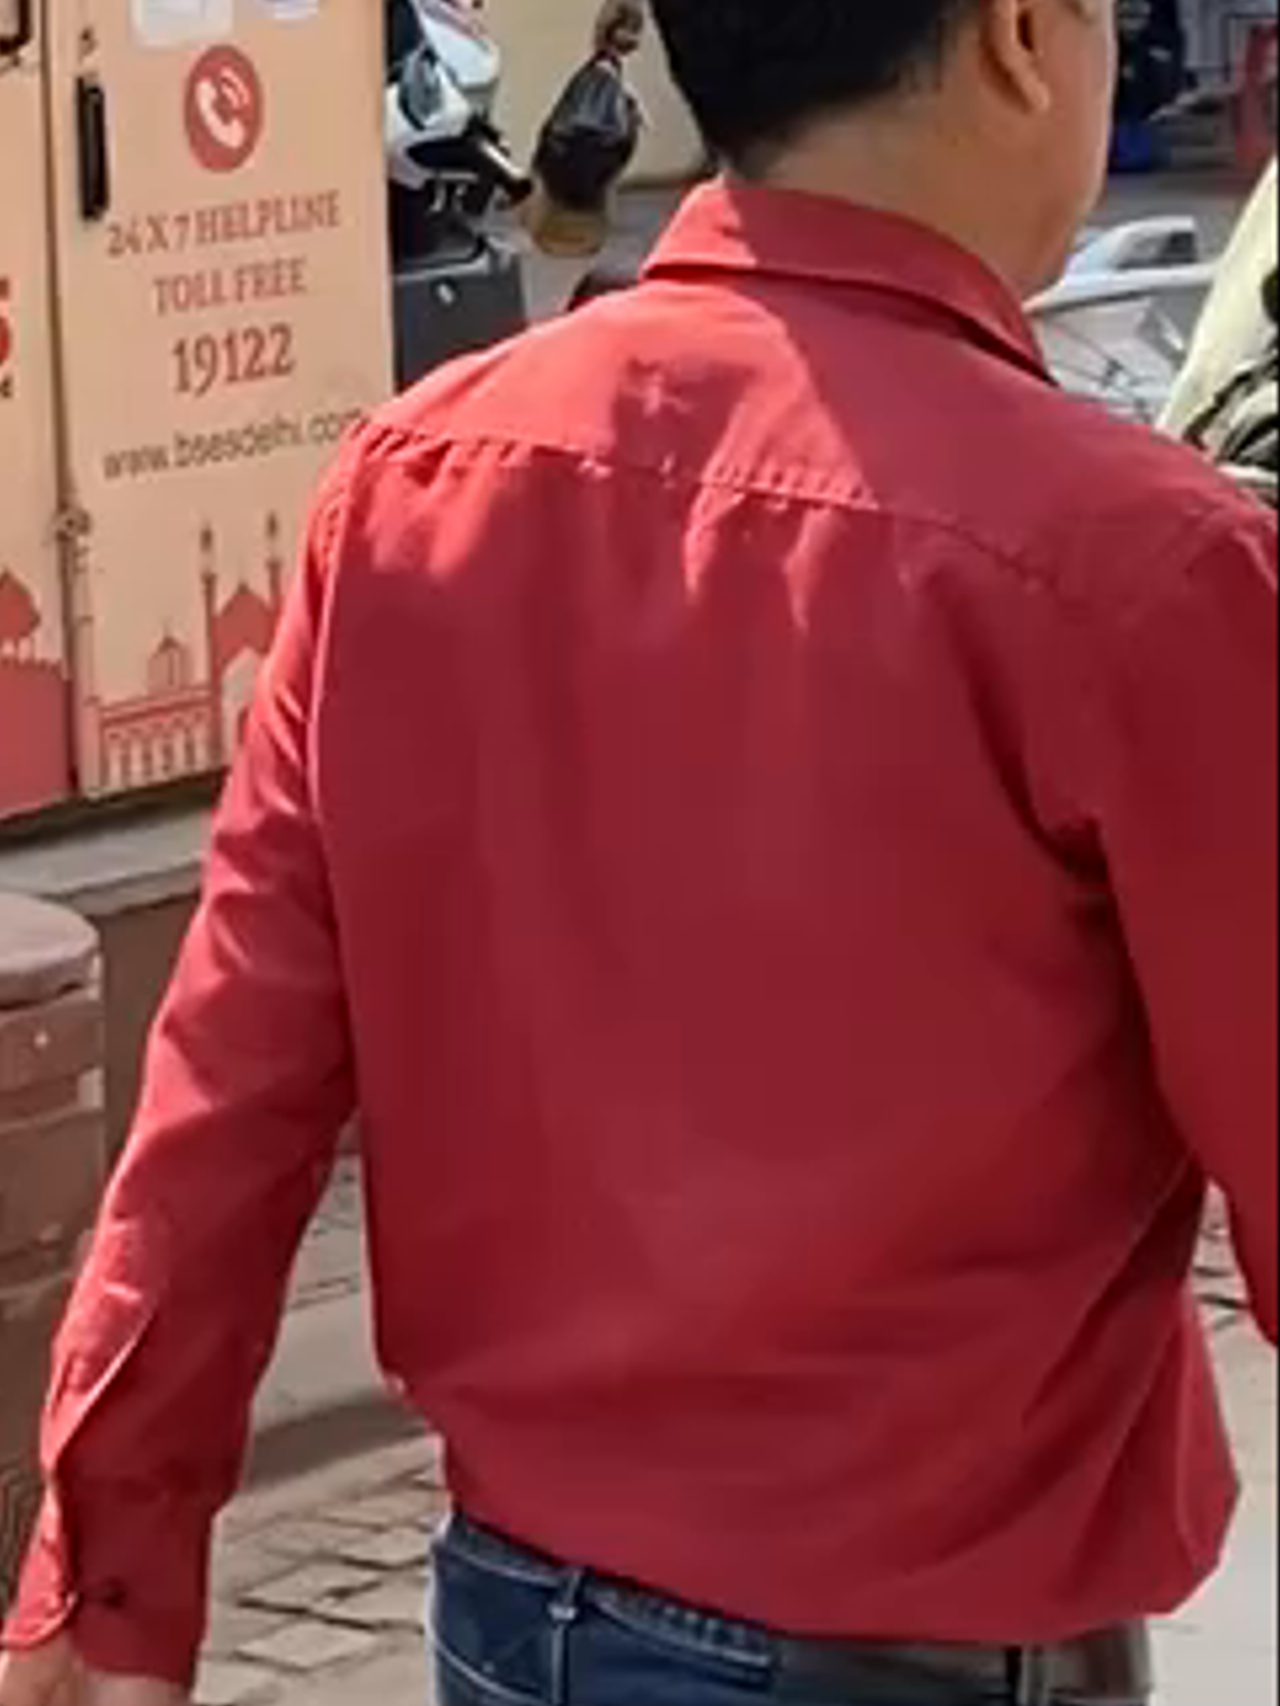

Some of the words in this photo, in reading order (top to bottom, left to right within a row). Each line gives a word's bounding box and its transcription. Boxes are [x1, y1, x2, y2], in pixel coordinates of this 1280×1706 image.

[195, 190, 343, 246] HELPLINE
[154, 268, 228, 316] TOLL
[236, 258, 308, 303] FREE
[172, 322, 297, 398] 19122
